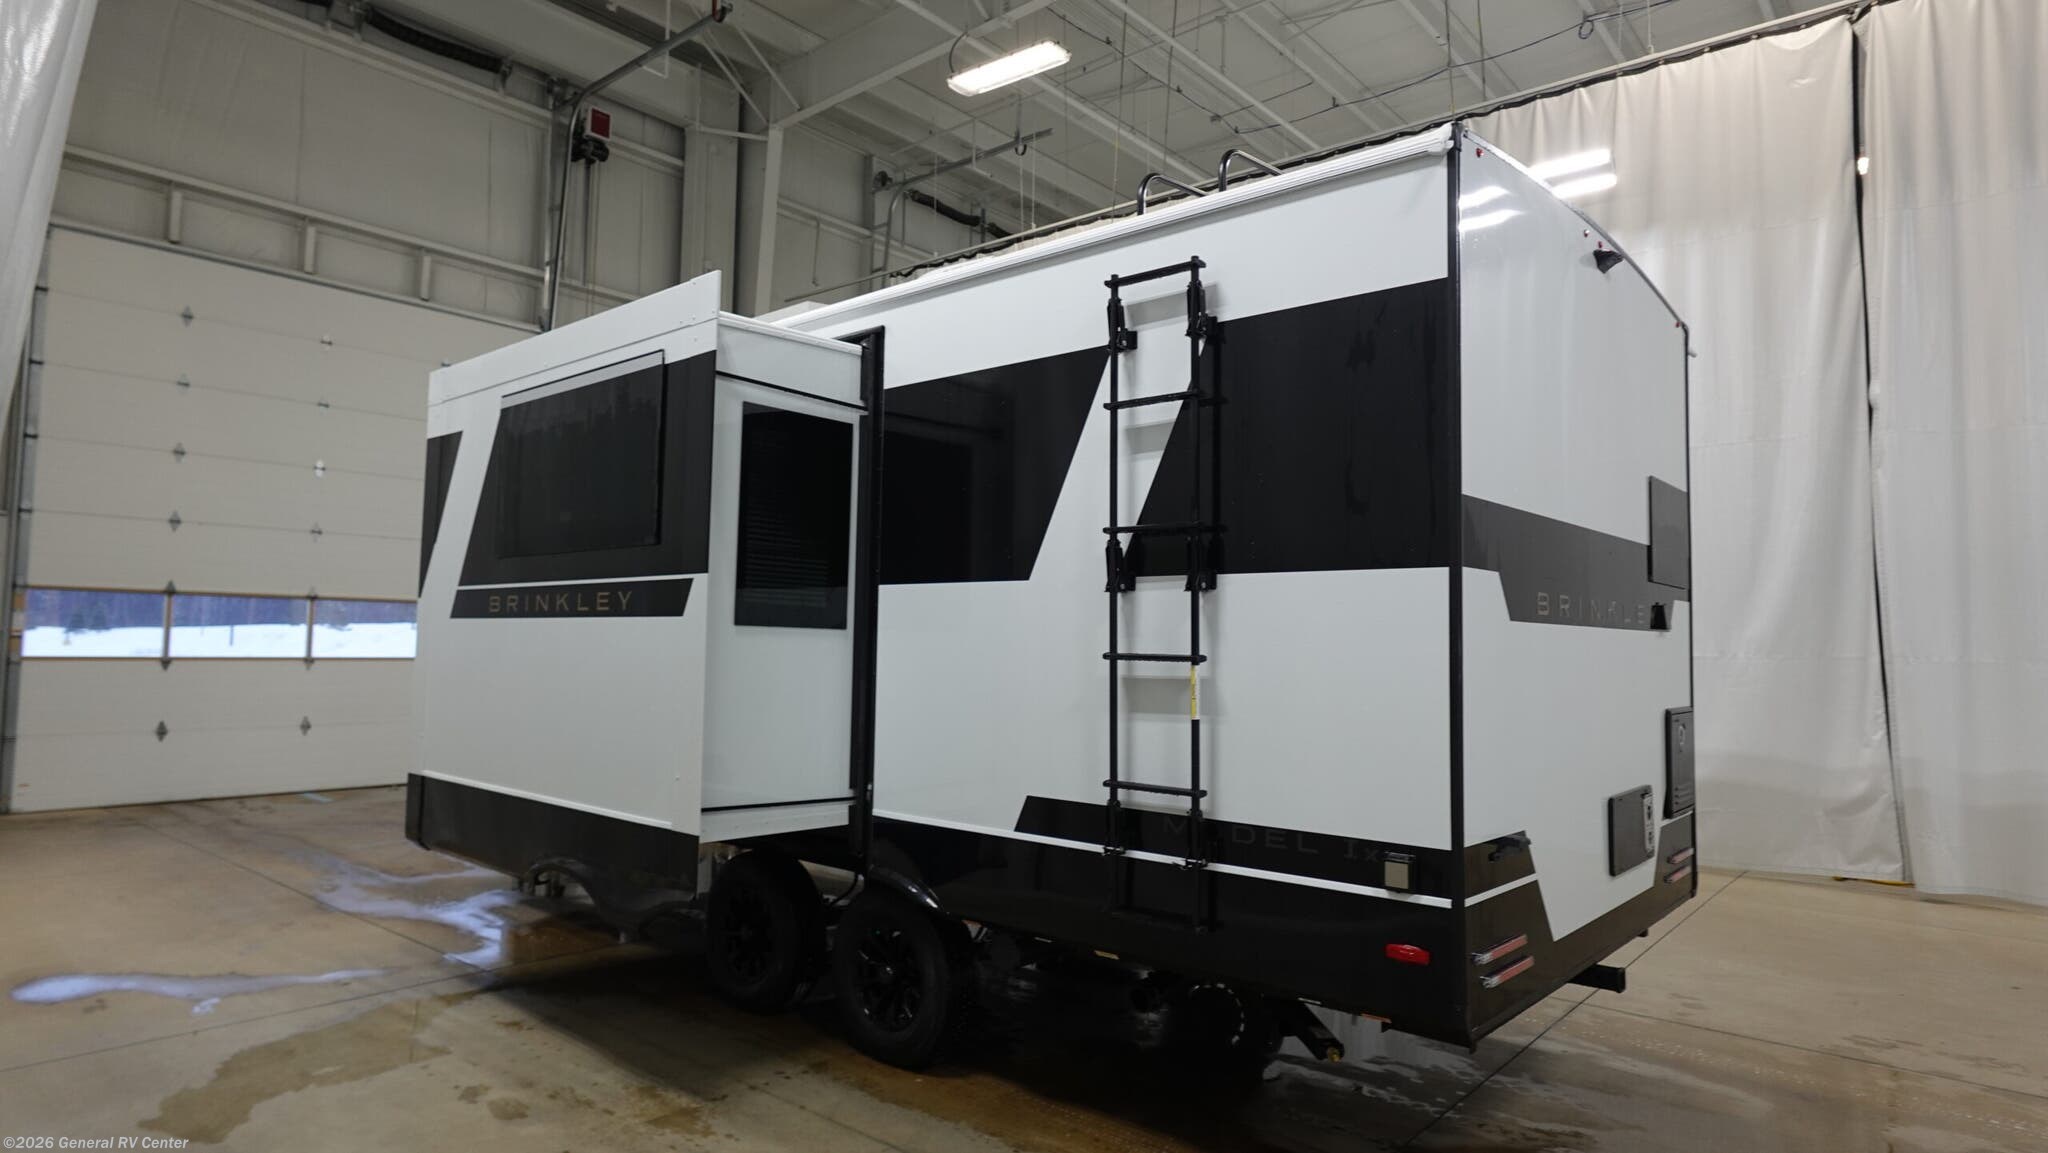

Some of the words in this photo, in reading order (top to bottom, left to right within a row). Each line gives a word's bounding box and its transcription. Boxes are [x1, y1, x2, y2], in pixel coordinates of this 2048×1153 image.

[488, 591, 632, 613] BRINKLEY
[1537, 591, 1647, 625] BRINKLE
[1164, 816, 1319, 854] MDEL
